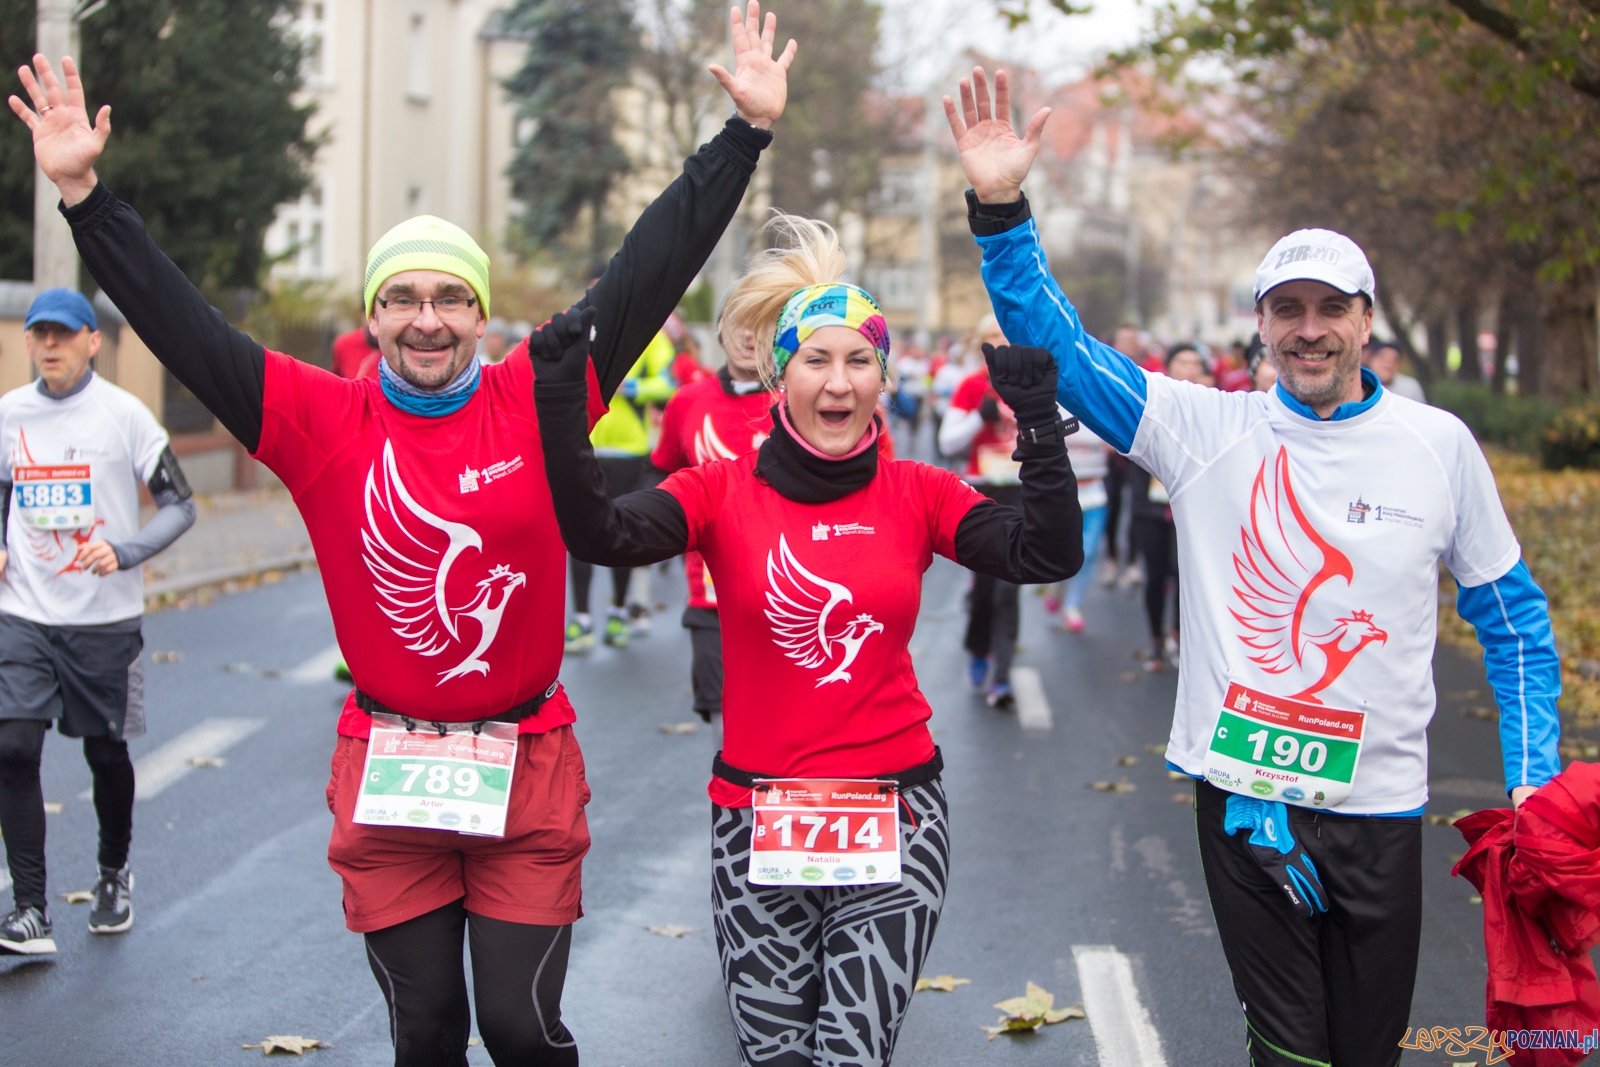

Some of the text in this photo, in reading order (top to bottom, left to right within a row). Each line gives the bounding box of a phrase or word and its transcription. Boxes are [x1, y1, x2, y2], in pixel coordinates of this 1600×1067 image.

[481, 467, 493, 484] 1
[22, 484, 84, 507] 5883
[1375, 505, 1383, 521] 1
[832, 524, 842, 536] 1
[1298, 714, 1354, 732] RunPoland.org
[447, 744, 505, 759] RunPoland.org
[1247, 729, 1328, 773] 190
[400, 763, 480, 797] 789
[1207, 774, 1233, 787] LUXMED
[1209, 768, 1230, 780] GRUPA
[1255, 768, 1299, 783] Krzysztof
[420, 799, 445, 808] Artur
[831, 792, 887, 802] RunPoland.org
[757, 814, 883, 849] B 1714
[807, 855, 841, 864] Natalia
[757, 873, 783, 881] LUXMED
